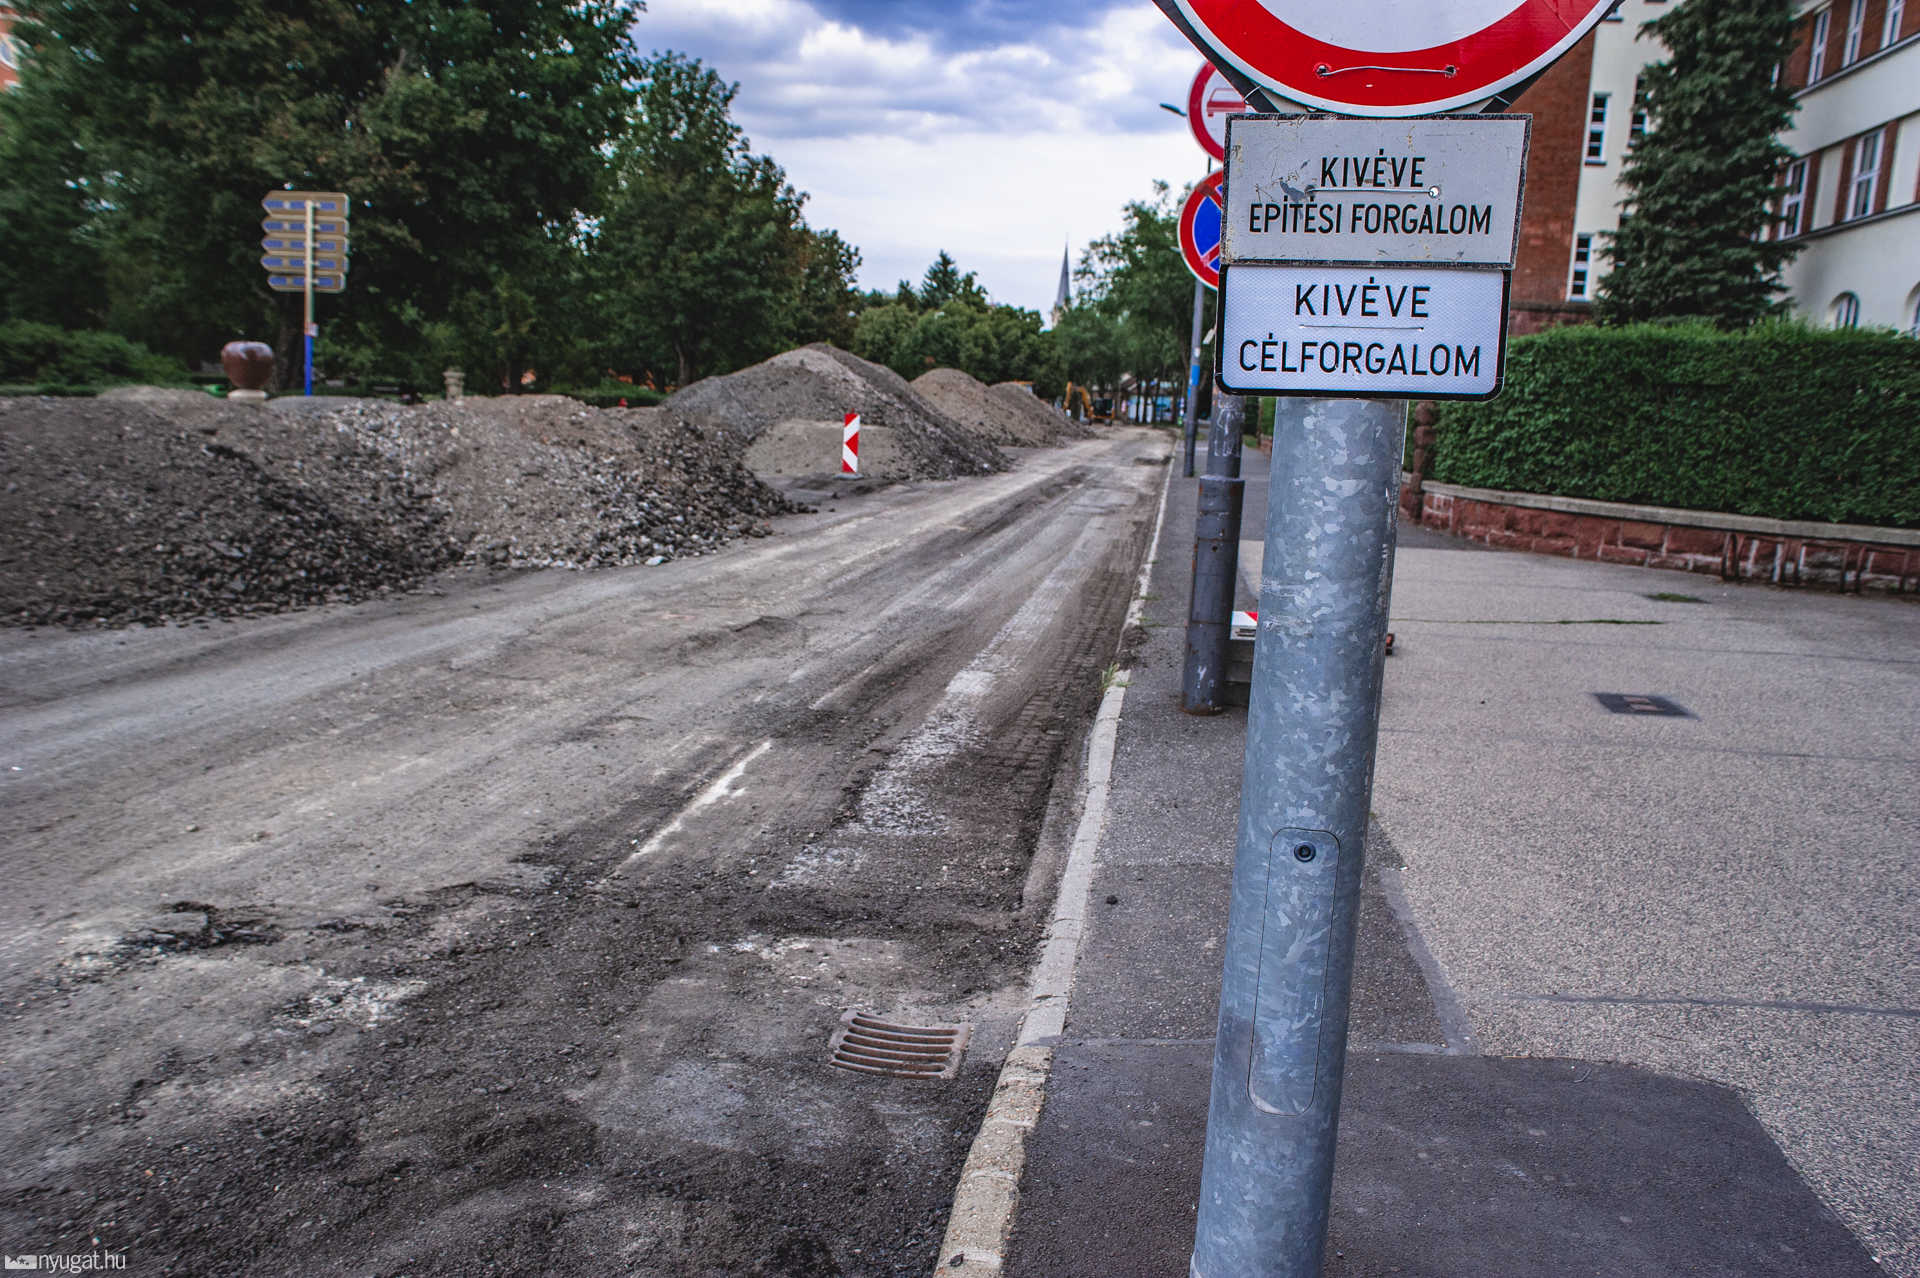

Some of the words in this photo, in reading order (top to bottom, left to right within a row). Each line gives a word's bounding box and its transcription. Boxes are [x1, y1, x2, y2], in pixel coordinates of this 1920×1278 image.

[1320, 148, 1426, 187] KIVÉVE
[1350, 204, 1492, 235] FORGALOM
[1294, 276, 1431, 318] KIVÉVE
[1238, 333, 1481, 377] CÉLFORGALOM
